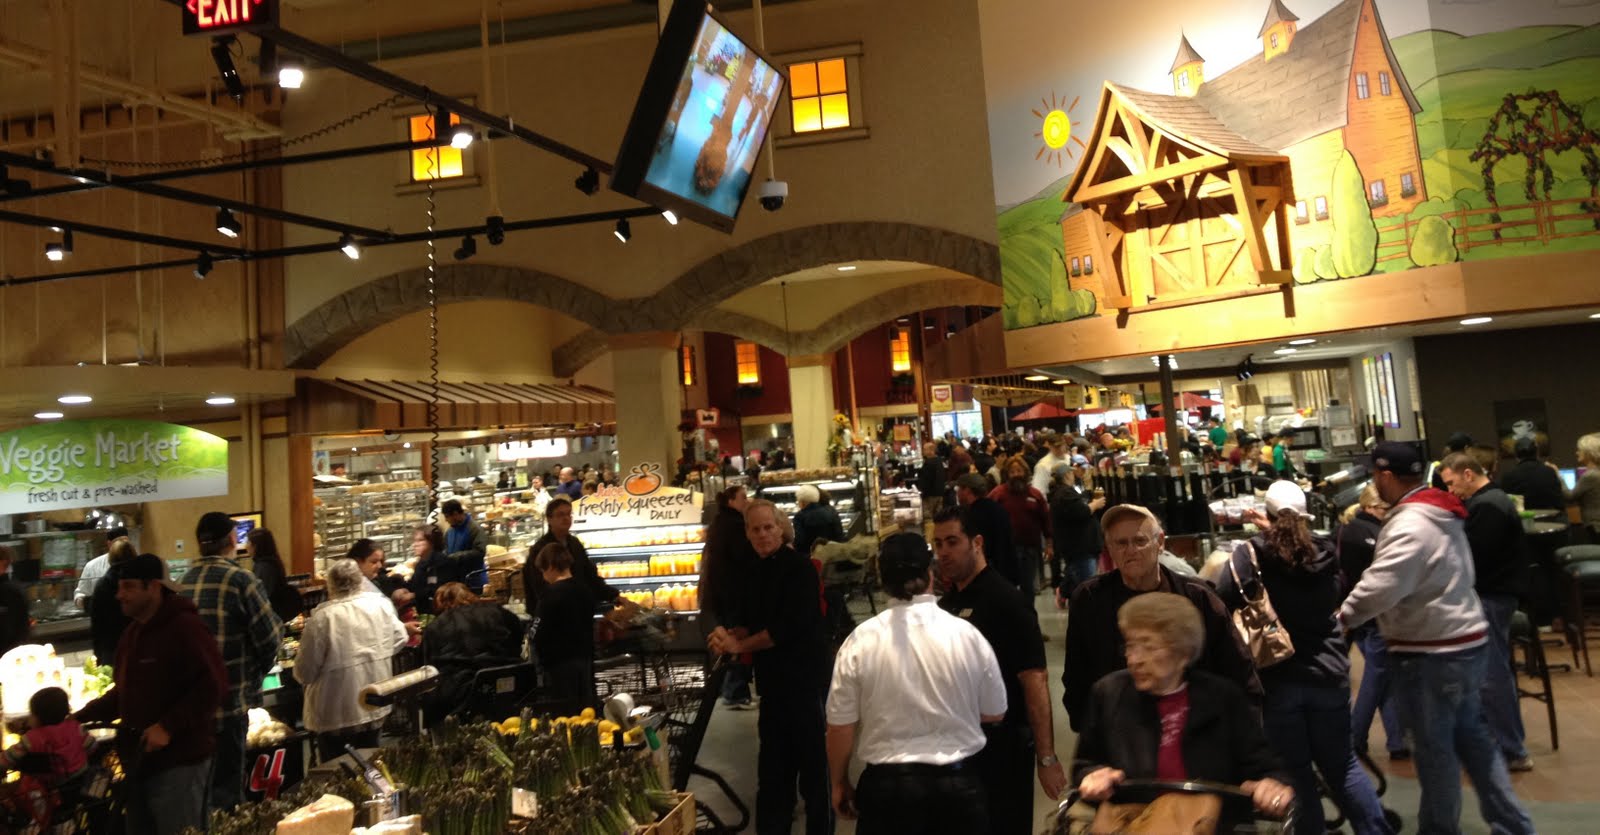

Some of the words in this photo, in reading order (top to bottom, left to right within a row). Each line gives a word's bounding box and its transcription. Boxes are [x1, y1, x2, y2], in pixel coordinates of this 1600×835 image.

[0, 435, 87, 483] Veggie
[95, 431, 181, 469] Market
[28, 487, 57, 504] fresh
[61, 485, 78, 500] cut
[83, 488, 91, 499] &
[95, 478, 158, 502] pre-washed
[578, 495, 624, 517] freshly
[627, 485, 694, 515] squeezed
[650, 509, 682, 520] DAILY
[250, 748, 287, 801] 4
